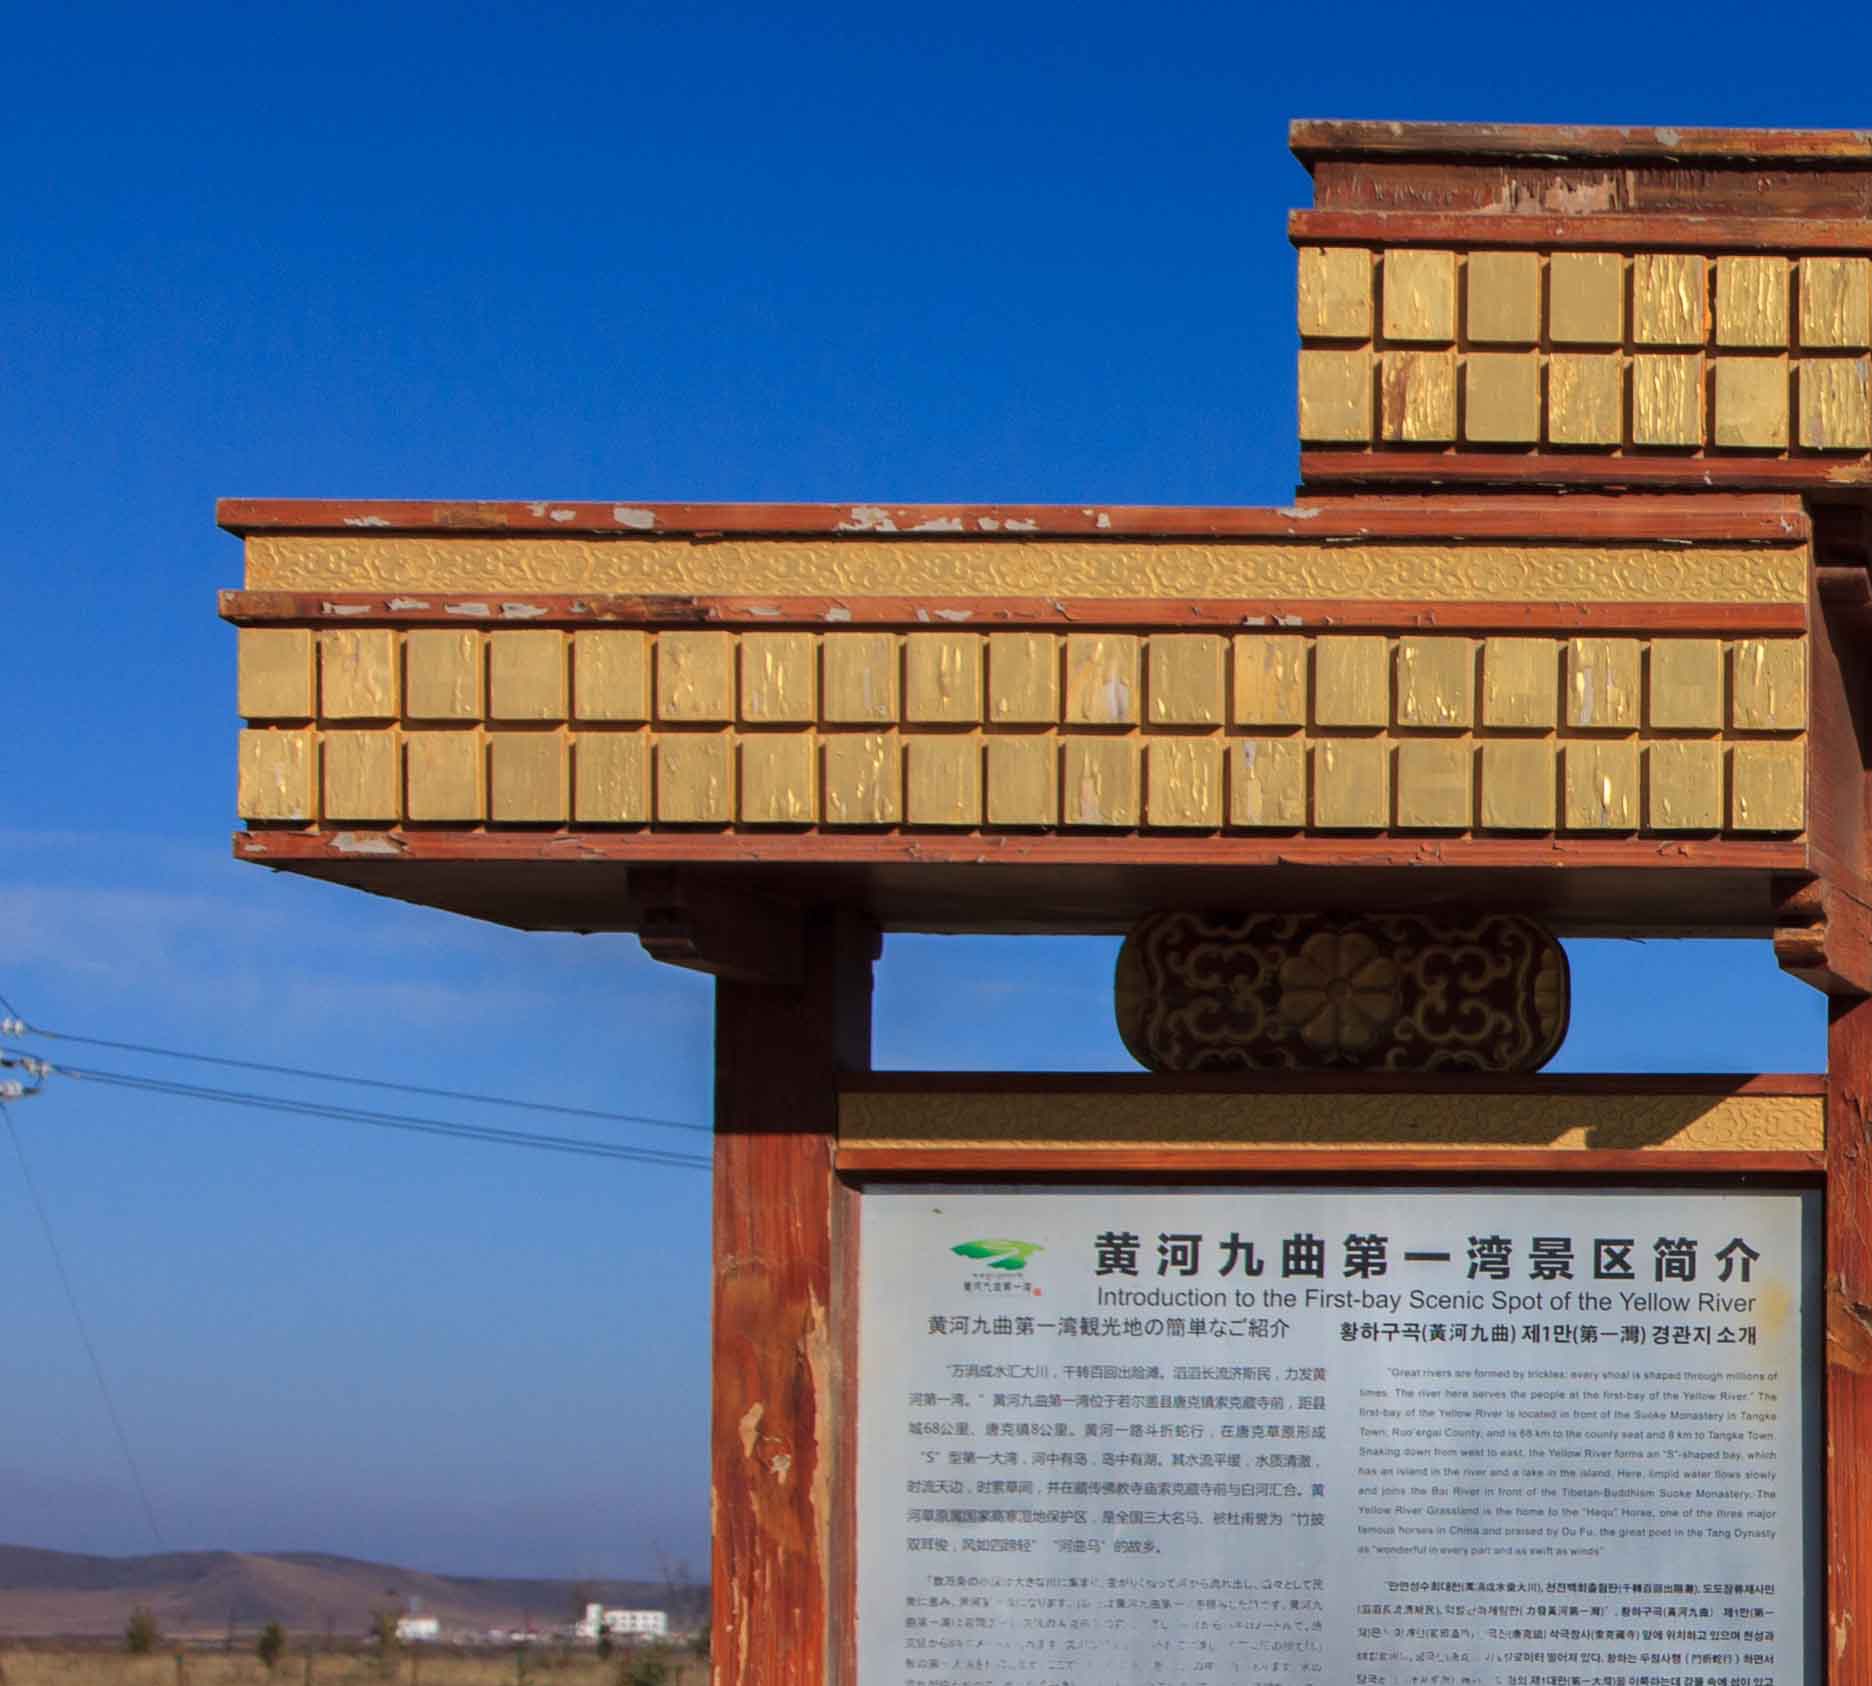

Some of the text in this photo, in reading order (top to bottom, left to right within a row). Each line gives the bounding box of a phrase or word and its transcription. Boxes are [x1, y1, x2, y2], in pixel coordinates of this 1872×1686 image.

[1094, 1231, 1760, 1283] 黄河九曲第一湾景区简介
[1098, 1287, 1756, 1315] Introduction to the First-bay Scenic Spot of the Yellow River
[927, 1315, 1291, 1339] 黄河九曲第一湾観光地の簡単なご紹介
[1652, 1324, 1711, 1345] 경관지
[1717, 1325, 1757, 1346] 소개
